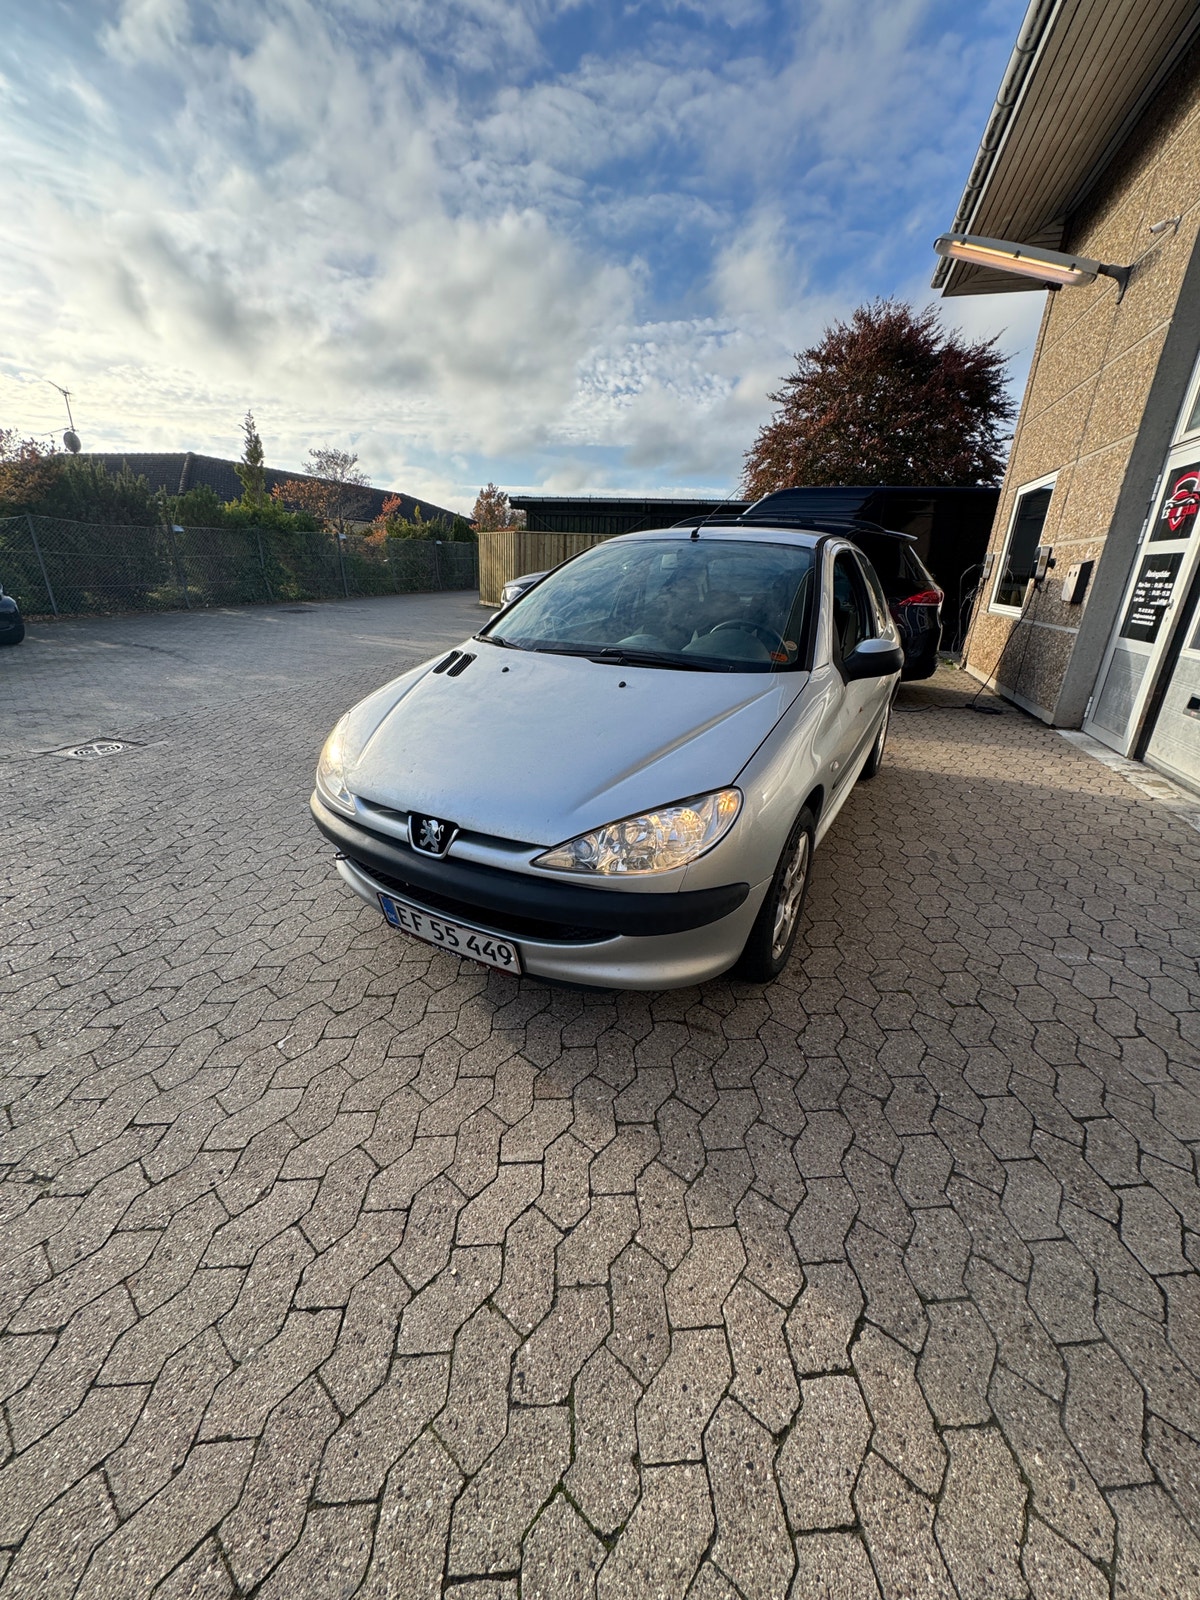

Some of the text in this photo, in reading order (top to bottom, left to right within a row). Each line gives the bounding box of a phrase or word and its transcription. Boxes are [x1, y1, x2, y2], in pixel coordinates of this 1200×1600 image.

[396, 905, 423, 932] EF
[430, 919, 460, 947] 55
[466, 935, 512, 966] 449
